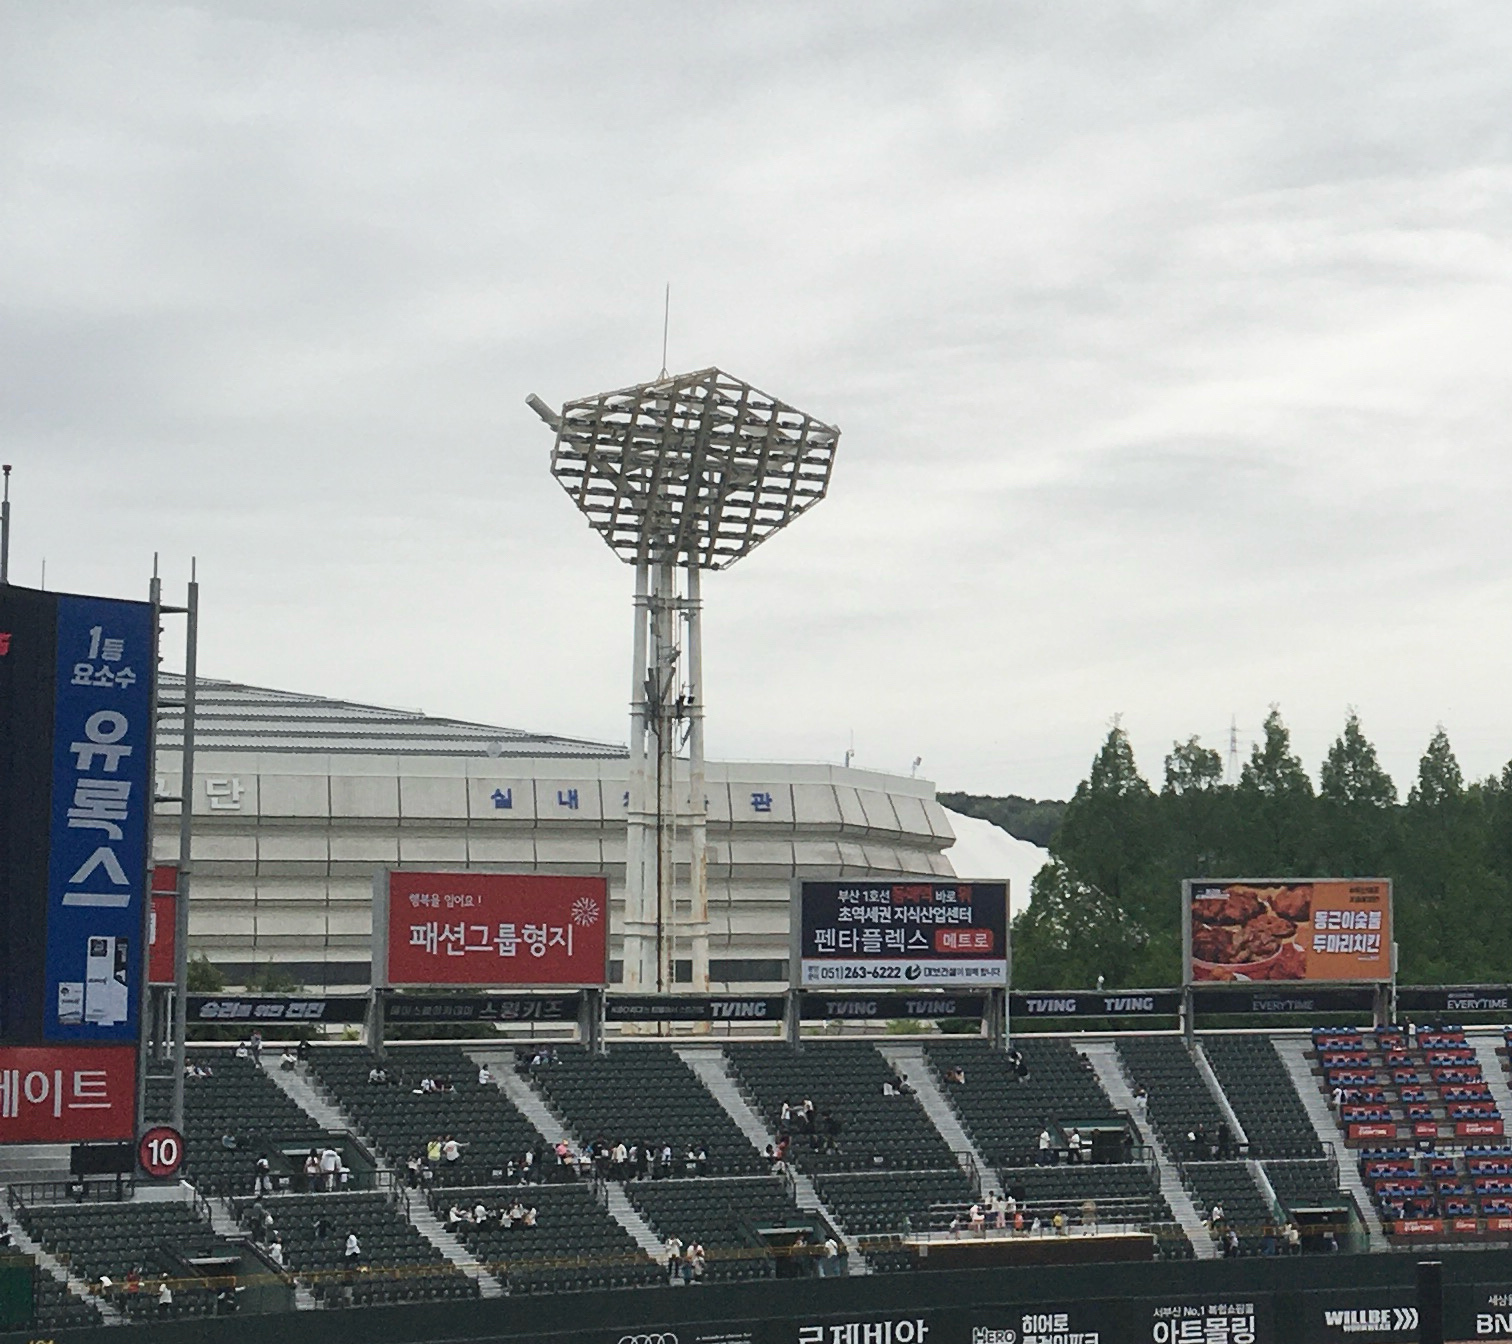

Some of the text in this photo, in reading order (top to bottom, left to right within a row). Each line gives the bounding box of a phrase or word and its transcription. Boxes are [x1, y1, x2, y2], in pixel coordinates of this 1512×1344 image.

[88, 626, 125, 662] 1등
[71, 663, 137, 689] 요소수
[62, 710, 133, 908] 유록스
[409, 893, 441, 907] 행복을
[837, 889, 860, 904] 부산
[863, 889, 890, 904] 1호선
[935, 889, 957, 904] 바로
[838, 906, 973, 924] 초역세권 지식산업센터
[409, 921, 573, 958] 패션그룹형지
[814, 927, 989, 953] 펜타플렉스 메트로
[1312, 934, 1382, 954] 두마리치킨
[821, 965, 901, 980] 051)263-6222
[710, 1002, 766, 1017] TVING
[826, 1000, 956, 1015] TVING TVING
[1026, 998, 1153, 1012] TVING TVING
[148, 1138, 178, 1166] 10
[1183, 1305, 1205, 1317] No.1
[1325, 1309, 1391, 1326] WILLBE
[1022, 1314, 1070, 1334] 히어로
